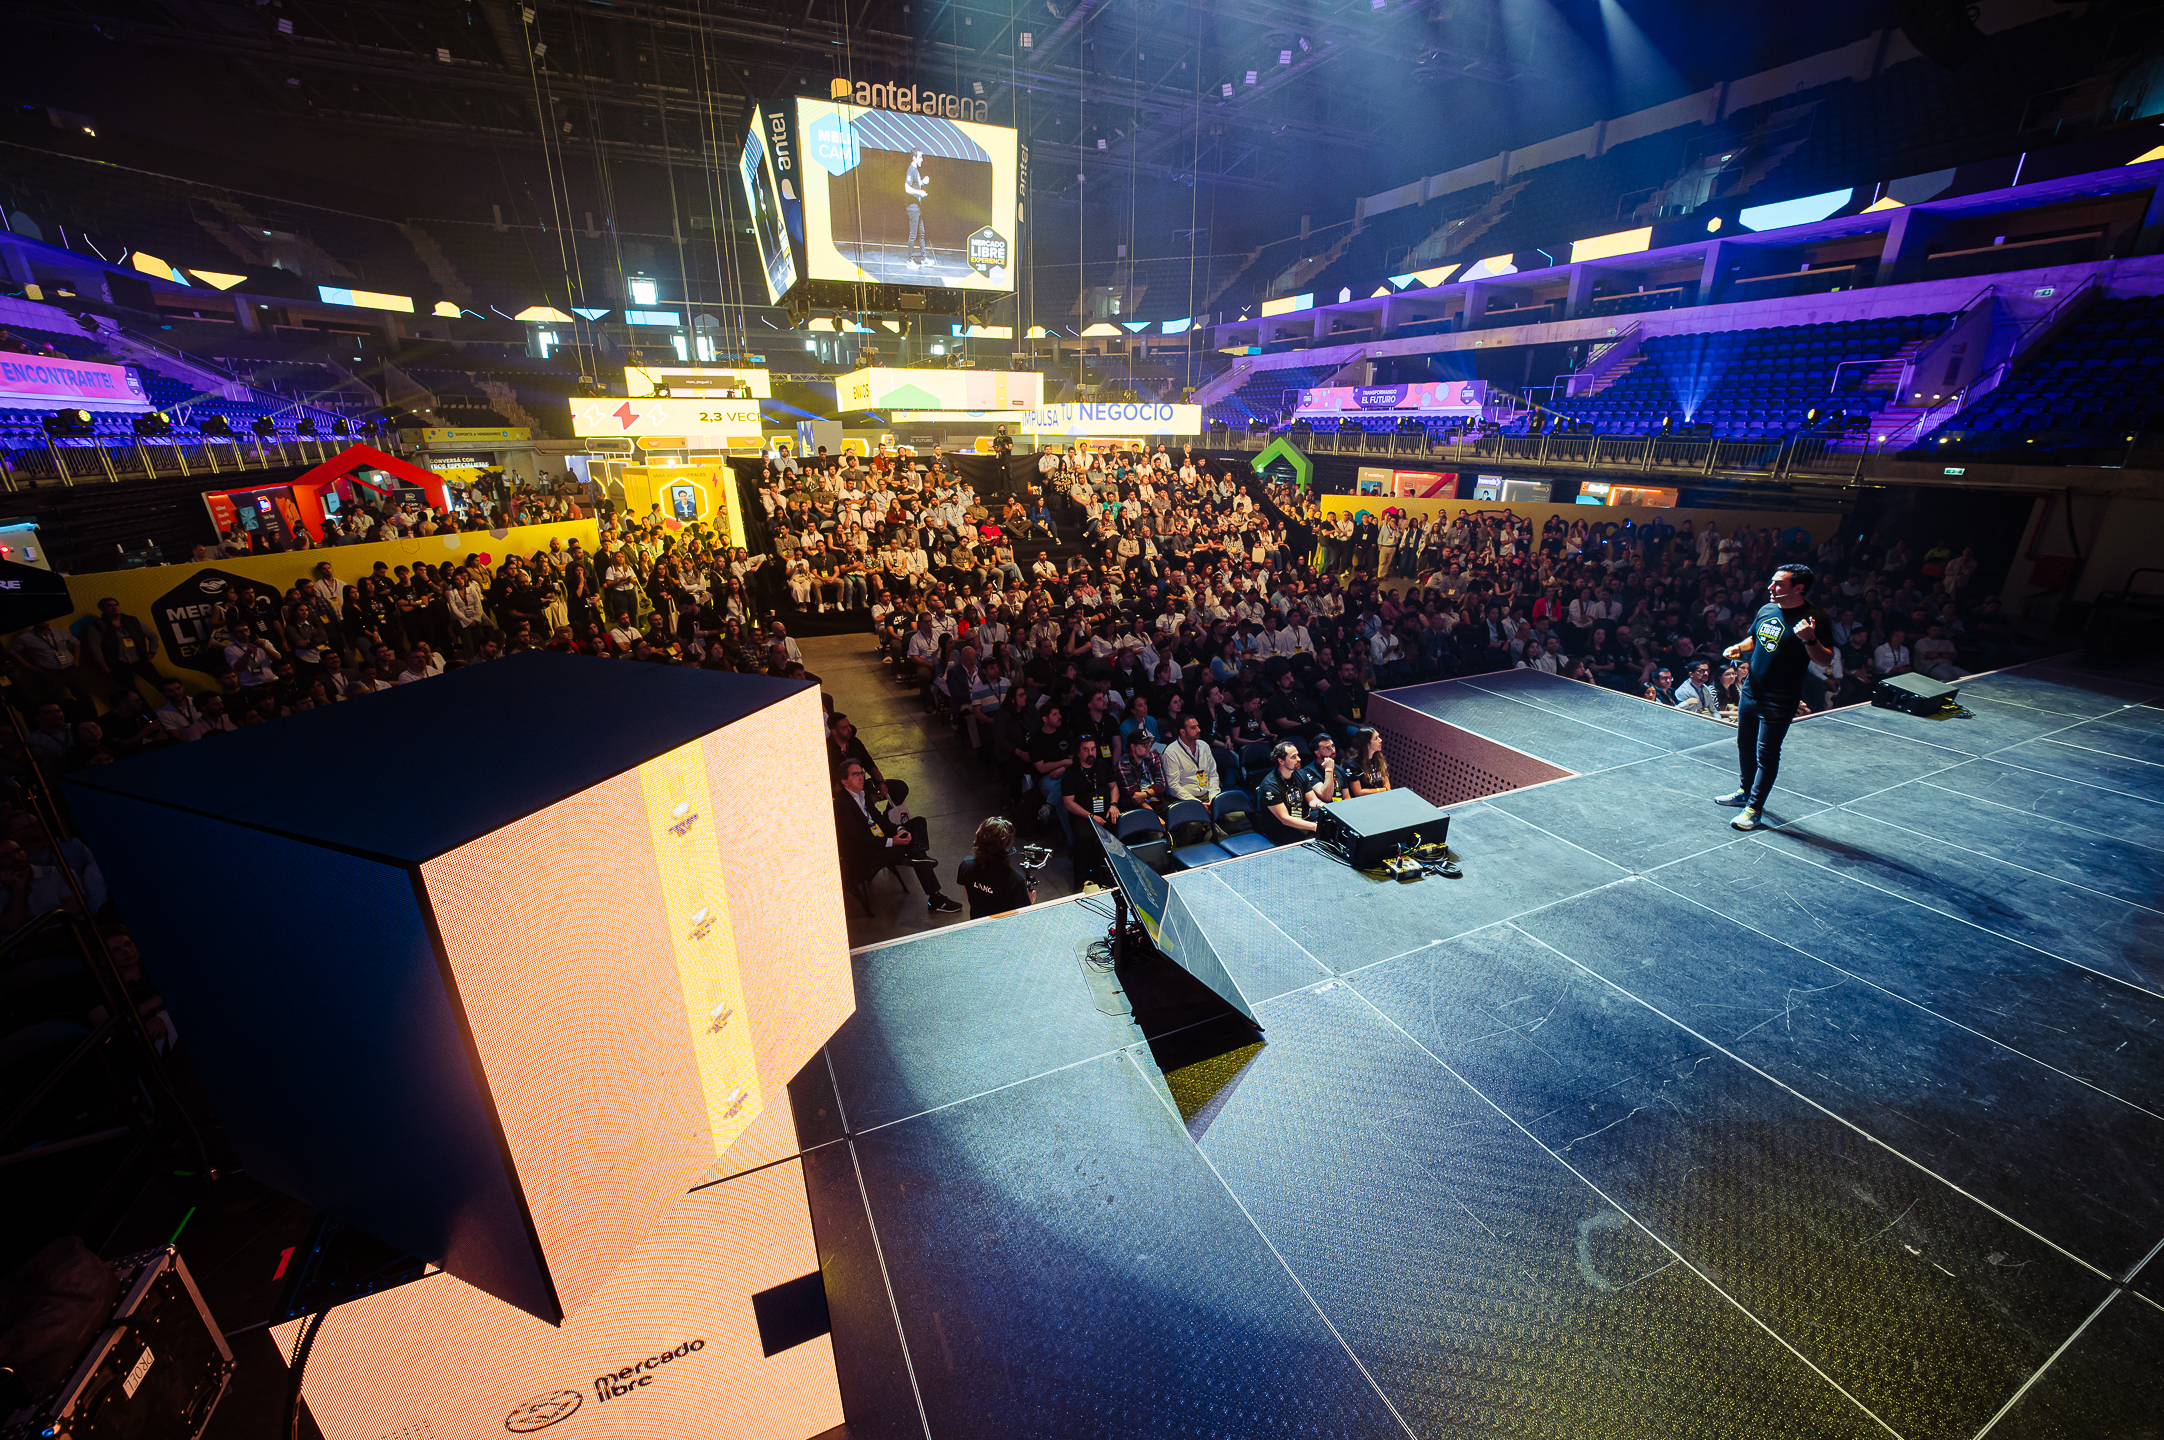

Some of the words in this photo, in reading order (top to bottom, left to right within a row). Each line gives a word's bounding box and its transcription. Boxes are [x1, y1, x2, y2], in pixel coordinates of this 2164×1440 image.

[768, 112, 791, 171] antel
[818, 129, 852, 145] MELI
[819, 144, 853, 160] CAM
[1020, 143, 1029, 197] antel
[971, 239, 1005, 248] MERCADO
[971, 246, 1005, 258] LIBRE
[971, 256, 1005, 265] EXPERIENCE
[1, 362, 115, 389] ENCONTRARTE!
[1361, 396, 1369, 404] EL
[1369, 395, 1396, 404] FUTURO
[699, 411, 723, 423] 2,3
[1061, 403, 1073, 421] TU
[1079, 403, 1173, 421] NEGOCIO
[124, 1349, 154, 1392] PROEL
[594, 1339, 705, 1388] mercado
